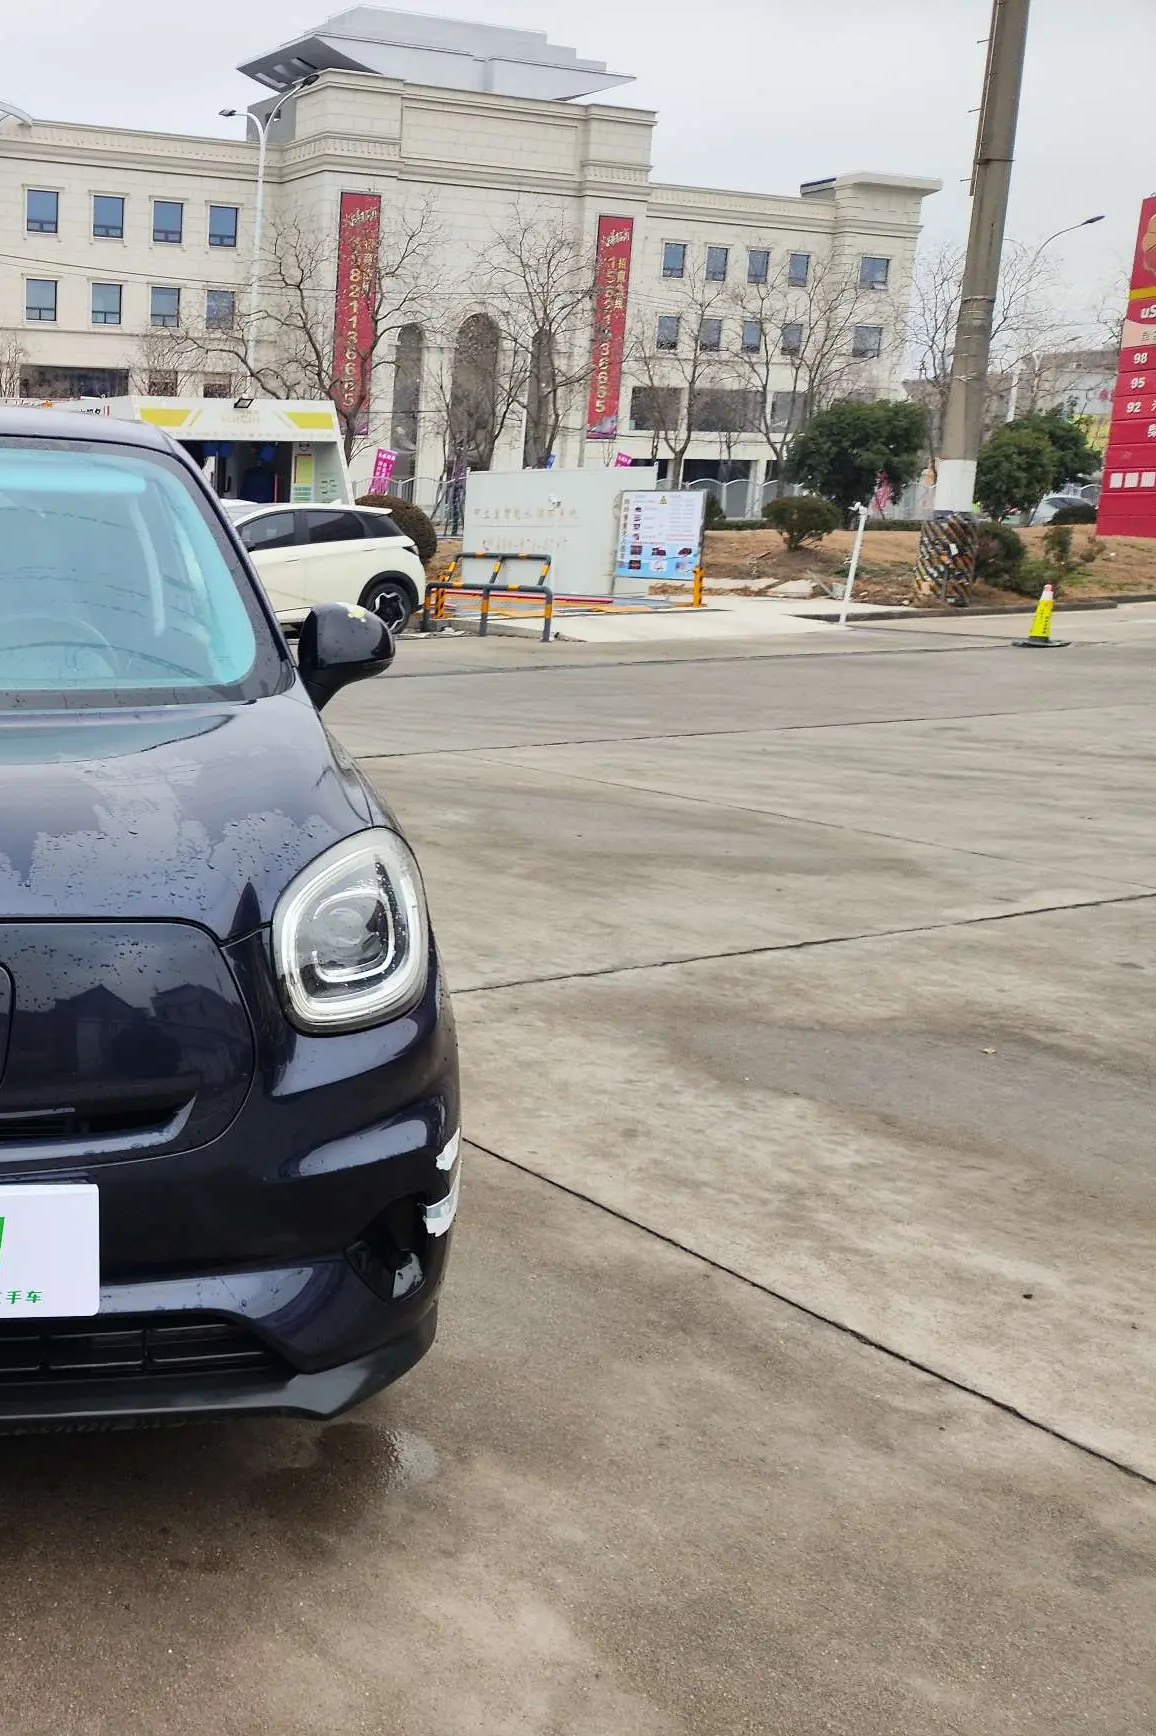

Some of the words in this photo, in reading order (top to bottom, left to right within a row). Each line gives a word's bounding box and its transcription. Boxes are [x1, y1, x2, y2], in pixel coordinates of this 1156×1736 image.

[1133, 352, 1148, 365] 98
[1130, 377, 1146, 389] 95
[1126, 401, 1142, 413] 92
